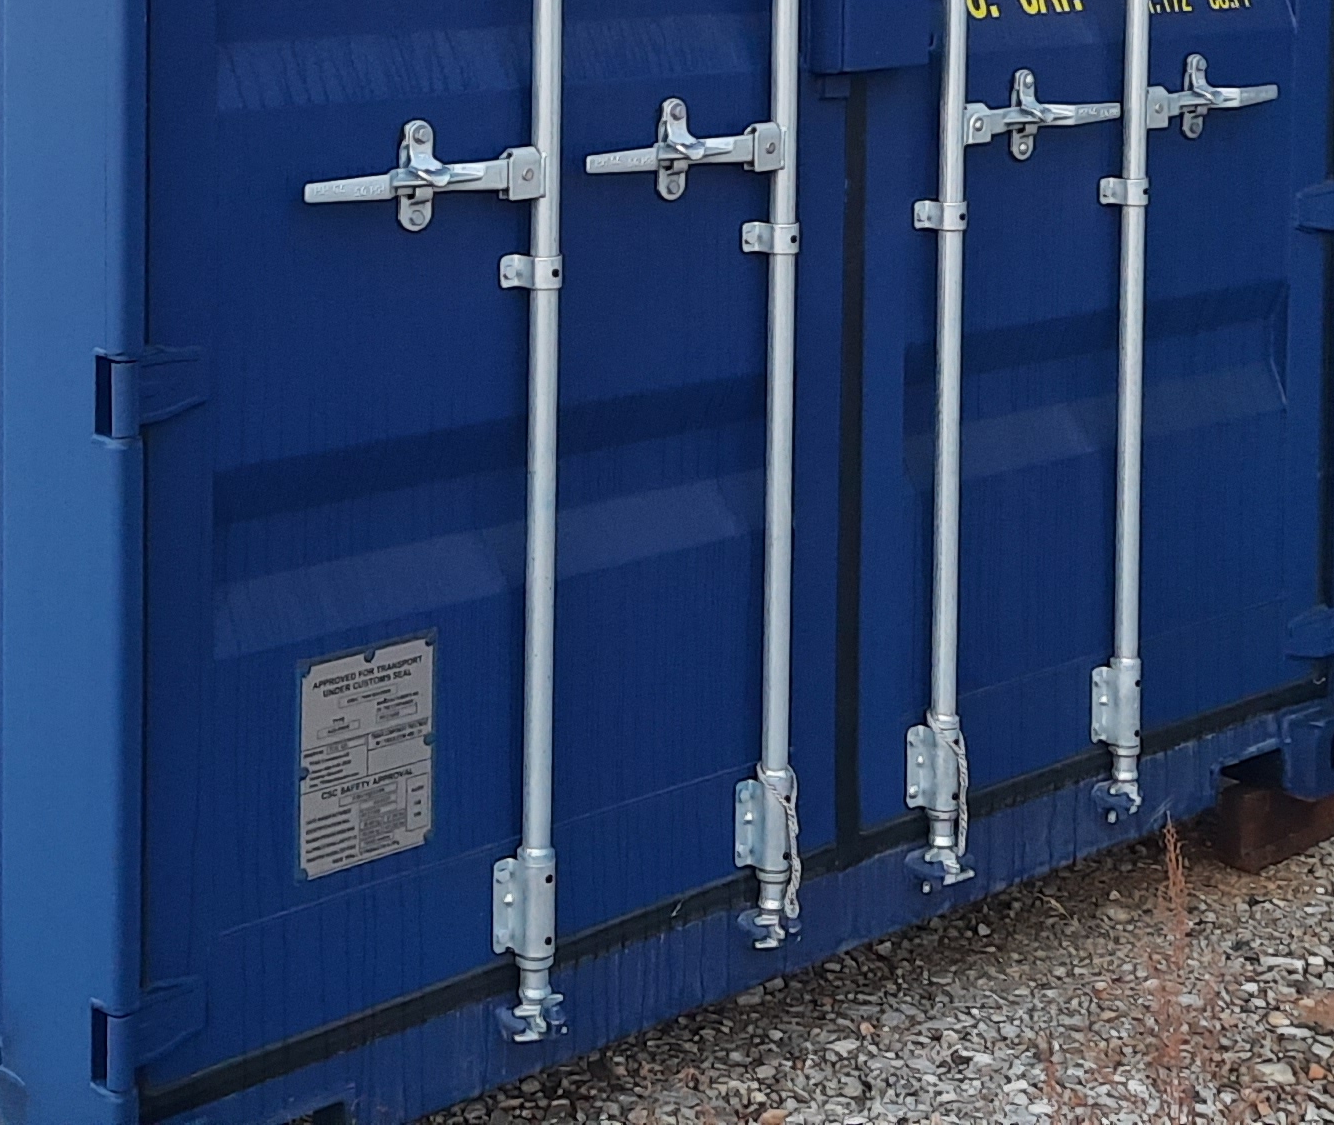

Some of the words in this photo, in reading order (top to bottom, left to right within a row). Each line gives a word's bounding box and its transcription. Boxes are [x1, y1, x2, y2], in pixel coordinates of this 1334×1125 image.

[312, 671, 357, 691] APPROVED
[358, 666, 375, 679] FOR
[376, 654, 423, 674] TRANSPORT
[323, 682, 351, 698] UNDER
[392, 668, 413, 681] SEAL
[320, 788, 339, 801] CSC
[340, 779, 370, 796] SAFETY
[372, 767, 413, 786] APPROVAL
